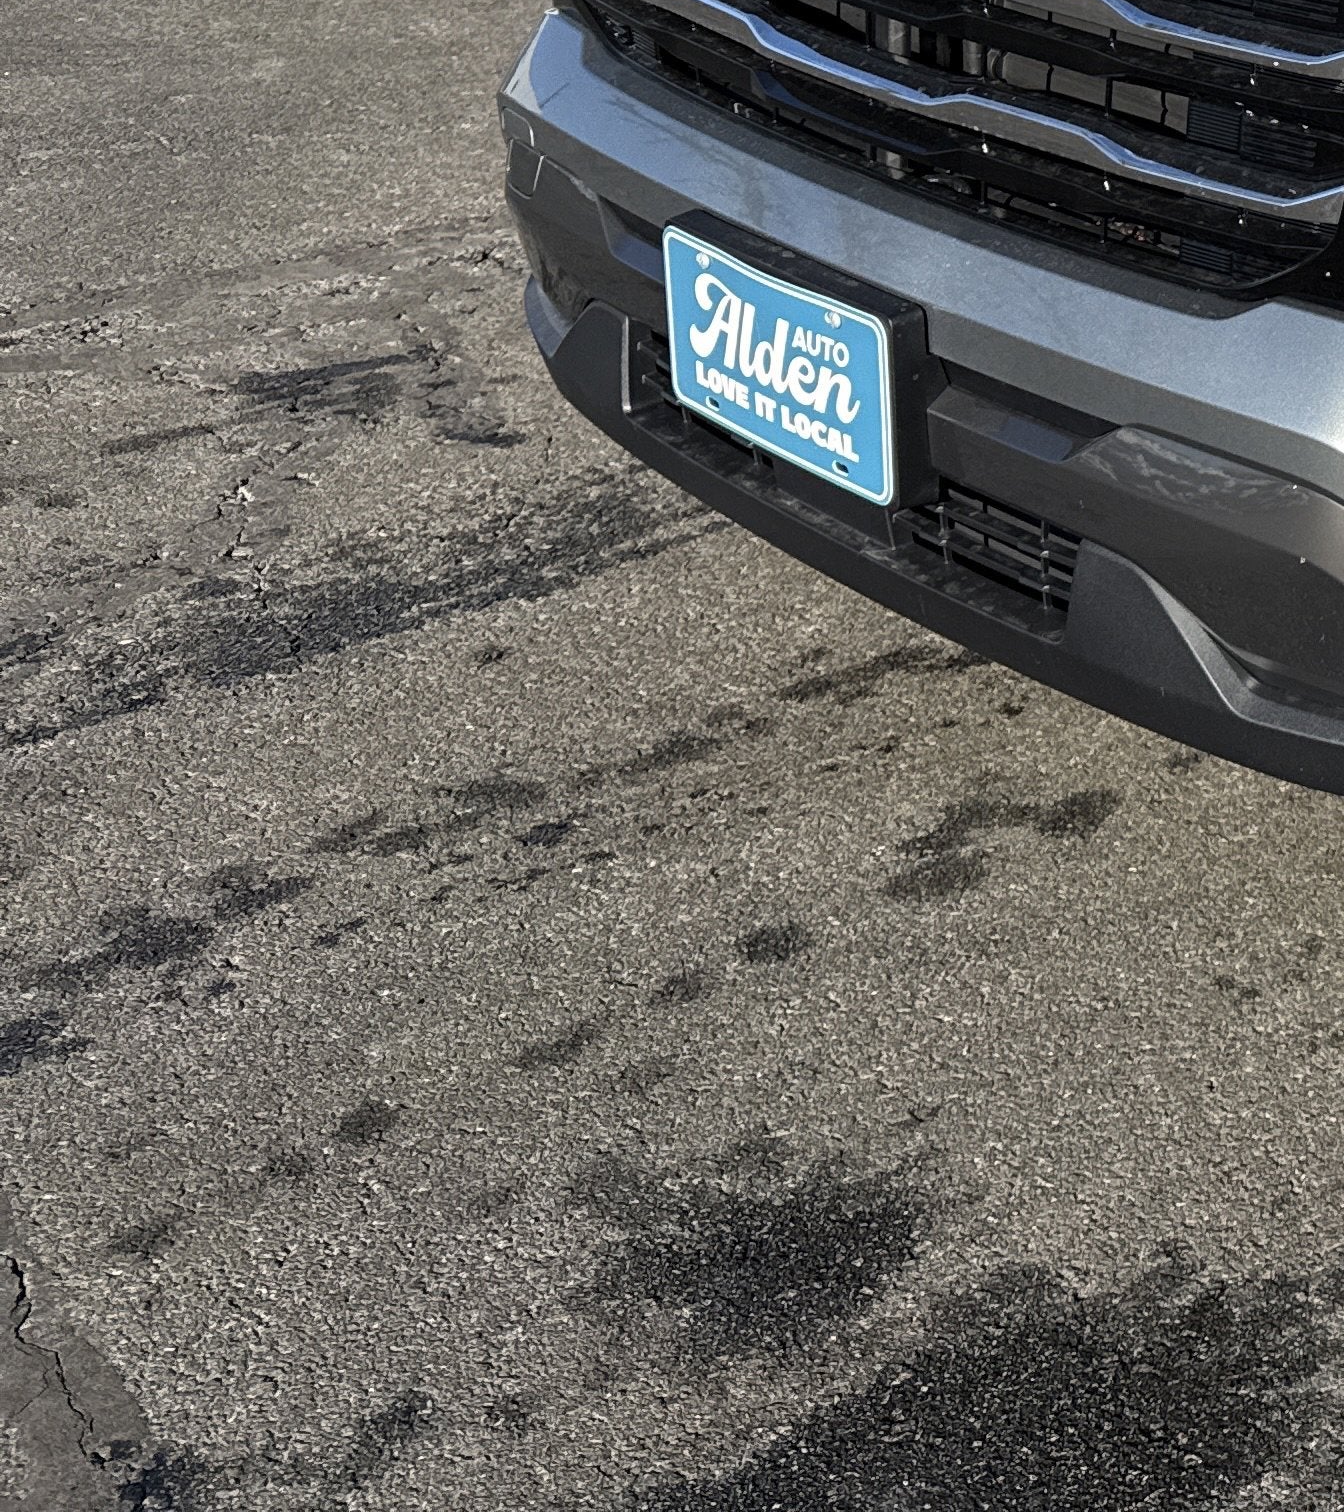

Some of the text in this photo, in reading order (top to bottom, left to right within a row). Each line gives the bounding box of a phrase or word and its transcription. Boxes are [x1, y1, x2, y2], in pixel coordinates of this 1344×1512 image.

[689, 272, 861, 424] Alden
[791, 326, 850, 368] AUTO
[695, 360, 860, 464] LOVE IT LOCAL
